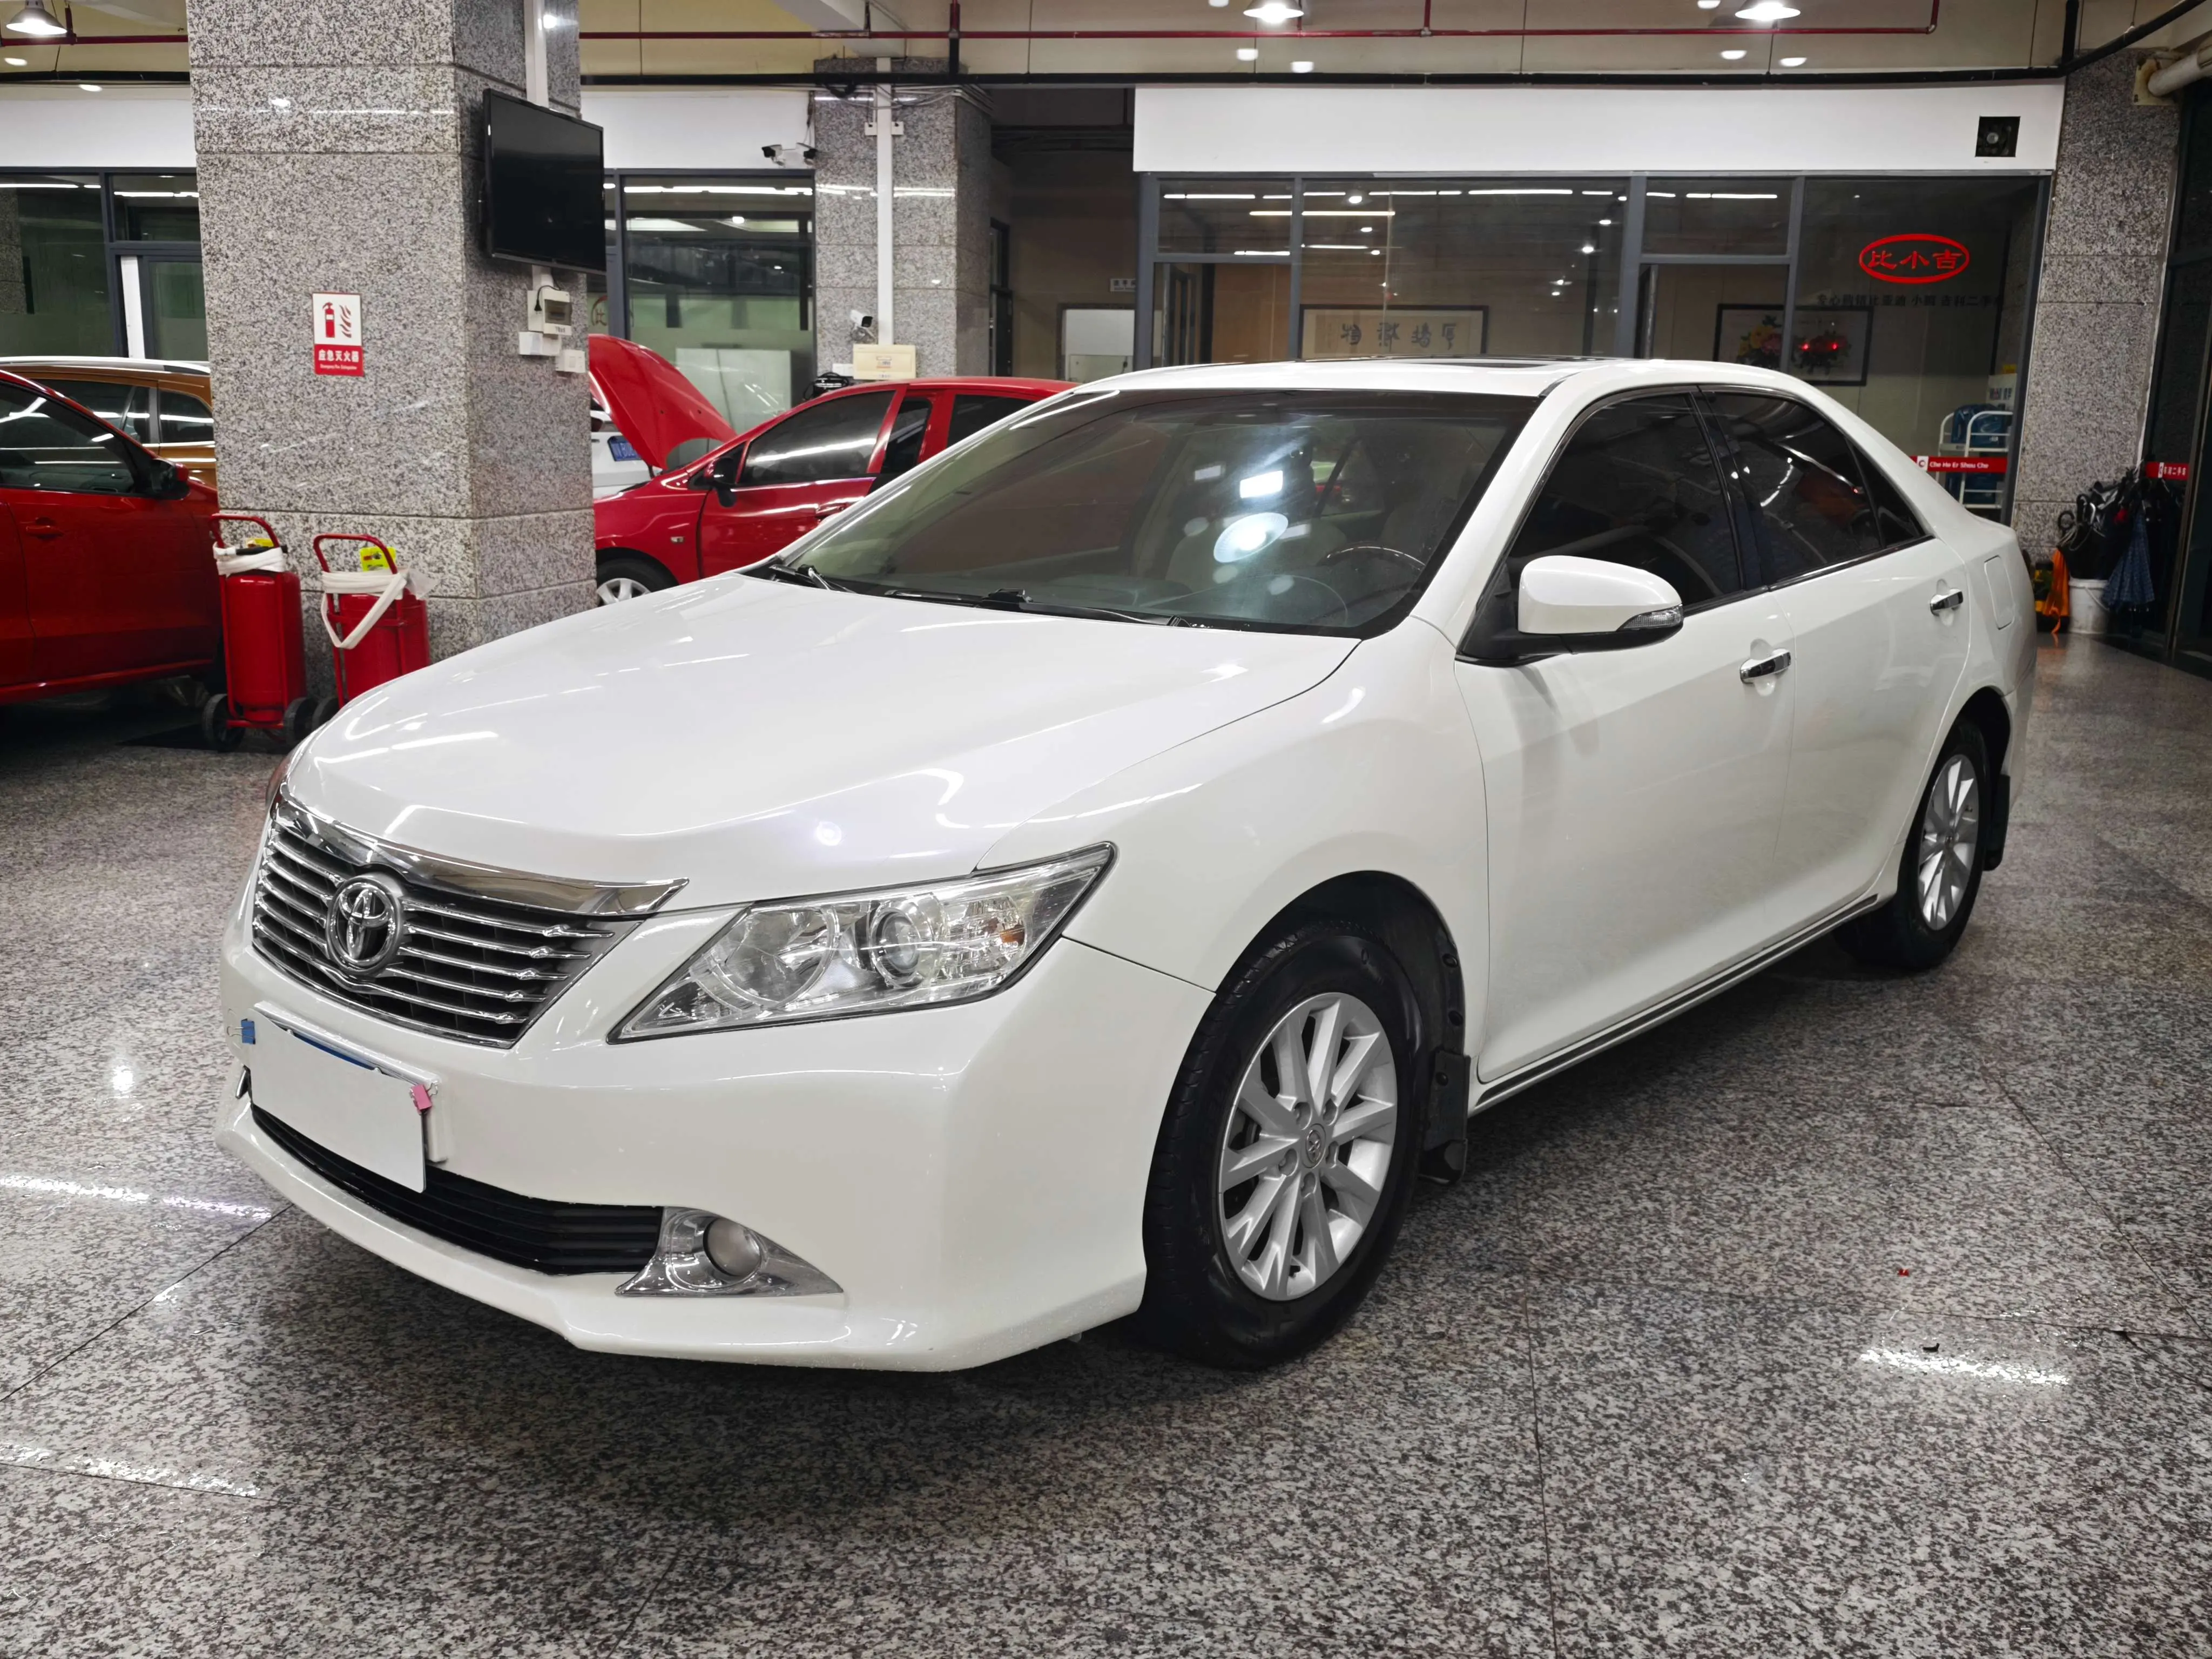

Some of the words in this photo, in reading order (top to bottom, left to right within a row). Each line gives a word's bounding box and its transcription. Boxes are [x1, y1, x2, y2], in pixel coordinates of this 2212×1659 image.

[1867, 248, 1963, 270] 比小吉
[318, 349, 359, 363] 应急灭火器
